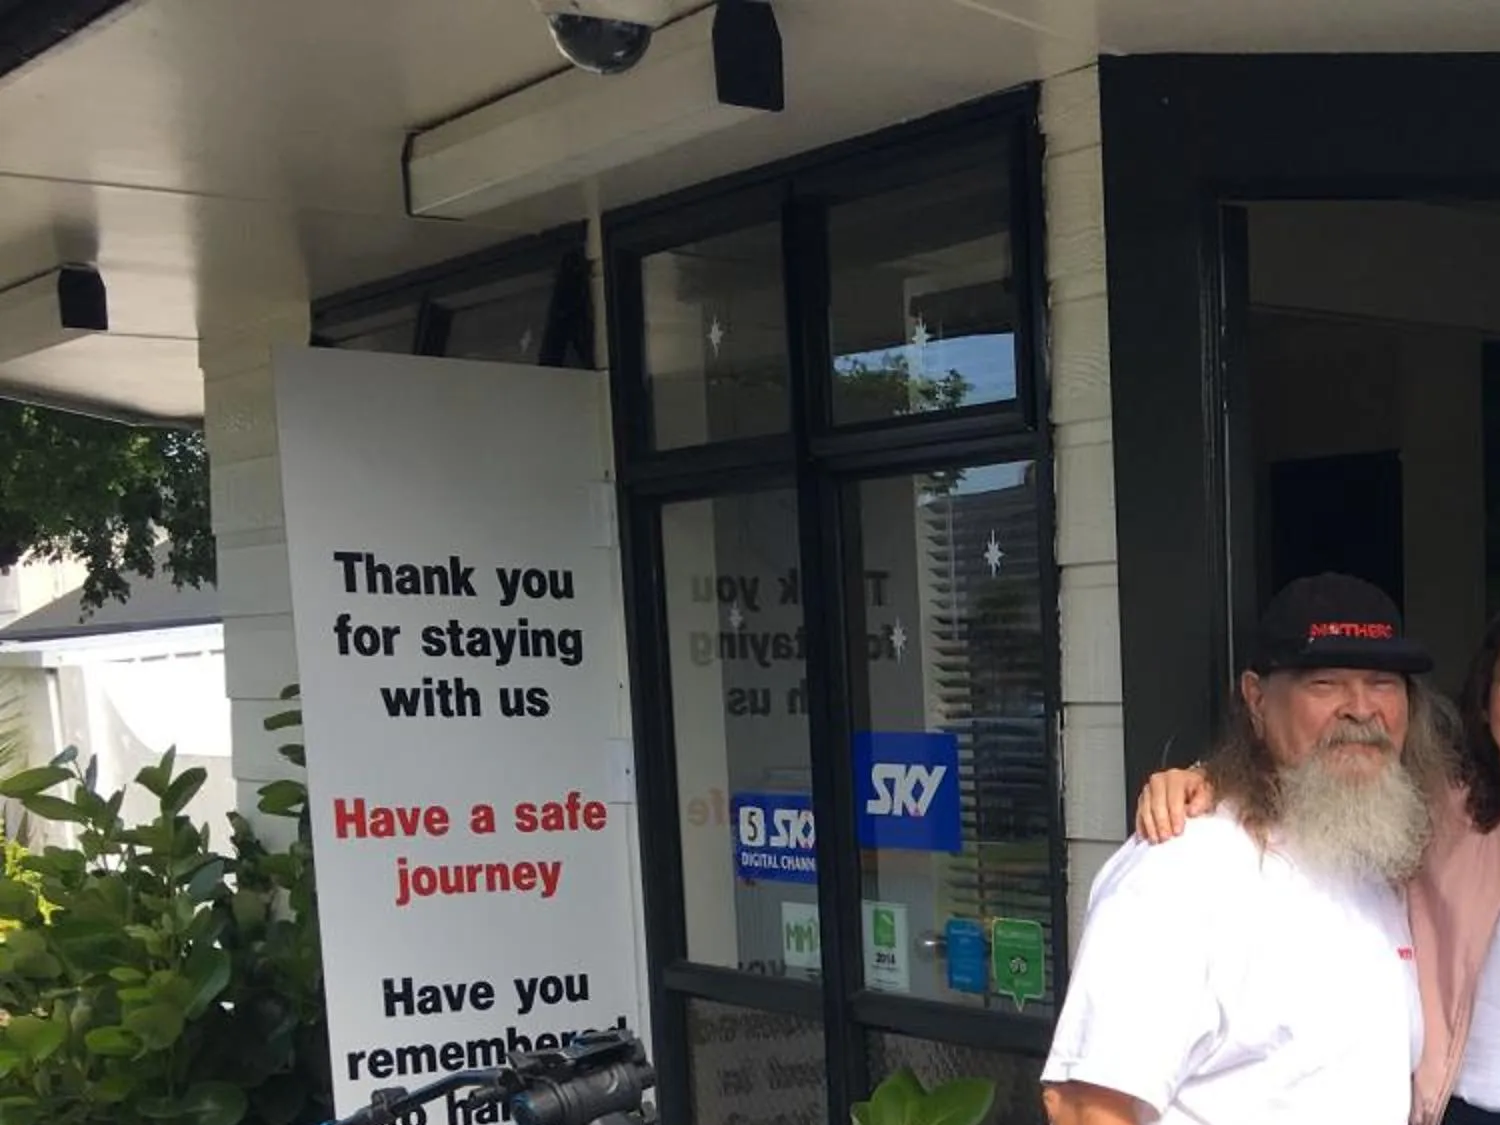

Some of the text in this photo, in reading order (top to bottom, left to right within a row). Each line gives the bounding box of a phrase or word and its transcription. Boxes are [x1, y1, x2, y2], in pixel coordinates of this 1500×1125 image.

[333, 551, 574, 606] Thank you
[334, 613, 583, 666] for staying
[380, 677, 550, 717] with us
[866, 763, 947, 817] SKY
[333, 791, 607, 839] Have a safe
[395, 857, 563, 906] journey
[741, 852, 779, 869] DIGITAL
[382, 973, 589, 1017] Have you
[348, 1017, 627, 1080] remember
